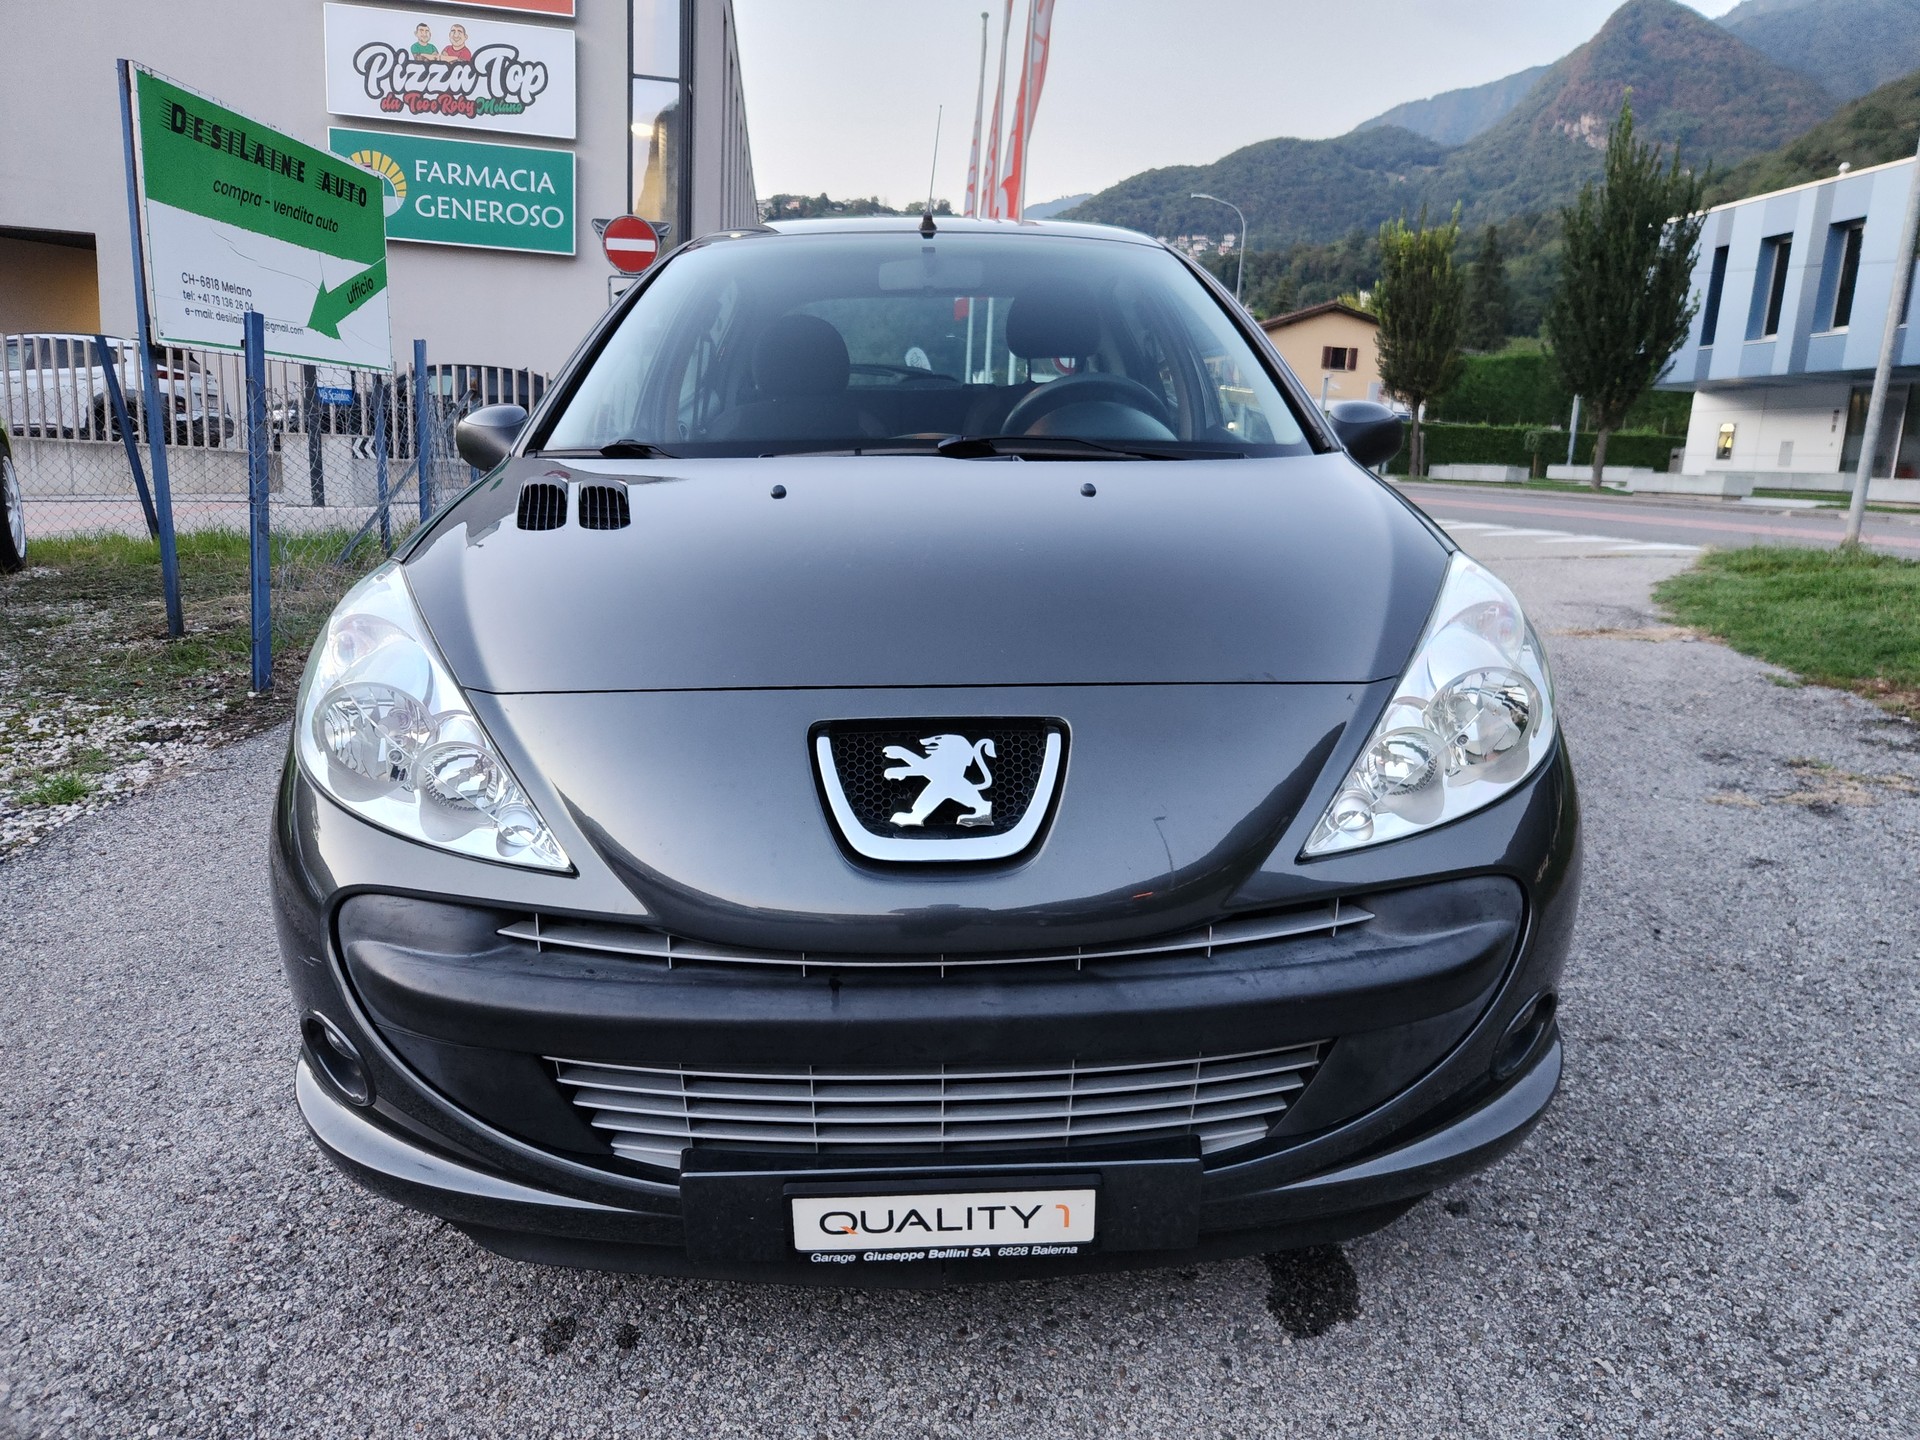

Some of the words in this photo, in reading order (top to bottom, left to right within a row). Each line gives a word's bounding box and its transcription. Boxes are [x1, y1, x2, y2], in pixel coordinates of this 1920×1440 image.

[353, 41, 477, 99] Pizza
[473, 43, 548, 106] Top
[380, 92, 403, 113] da
[437, 93, 477, 119] Roby
[163, 98, 305, 183] DESILAINE
[318, 170, 367, 207] AUTO
[415, 160, 555, 194] FARMACIA
[213, 180, 262, 206] compra
[273, 201, 314, 224] vendita
[316, 215, 339, 233] auto
[415, 195, 564, 228] GENEROSO
[181, 272, 219, 290] CH-6818
[222, 281, 252, 297] Melano
[347, 277, 374, 304] ufficio
[183, 290, 195, 301] tel:
[197, 294, 210, 303] +41
[212, 295, 220, 305] 79
[221, 297, 234, 308] 136
[235, 299, 243, 310] 26
[185, 307, 214, 319] e-mail:
[819, 1204, 1043, 1235] QUALITY
[1056, 1204, 1070, 1228] 1
[810, 1252, 856, 1264] Garage
[863, 1250, 925, 1263] Giuseppe
[928, 1248, 969, 1260] Bellini
[972, 1247, 991, 1258] SA
[998, 1246, 1028, 1256] 6828
[1031, 1245, 1078, 1256] Balerna
